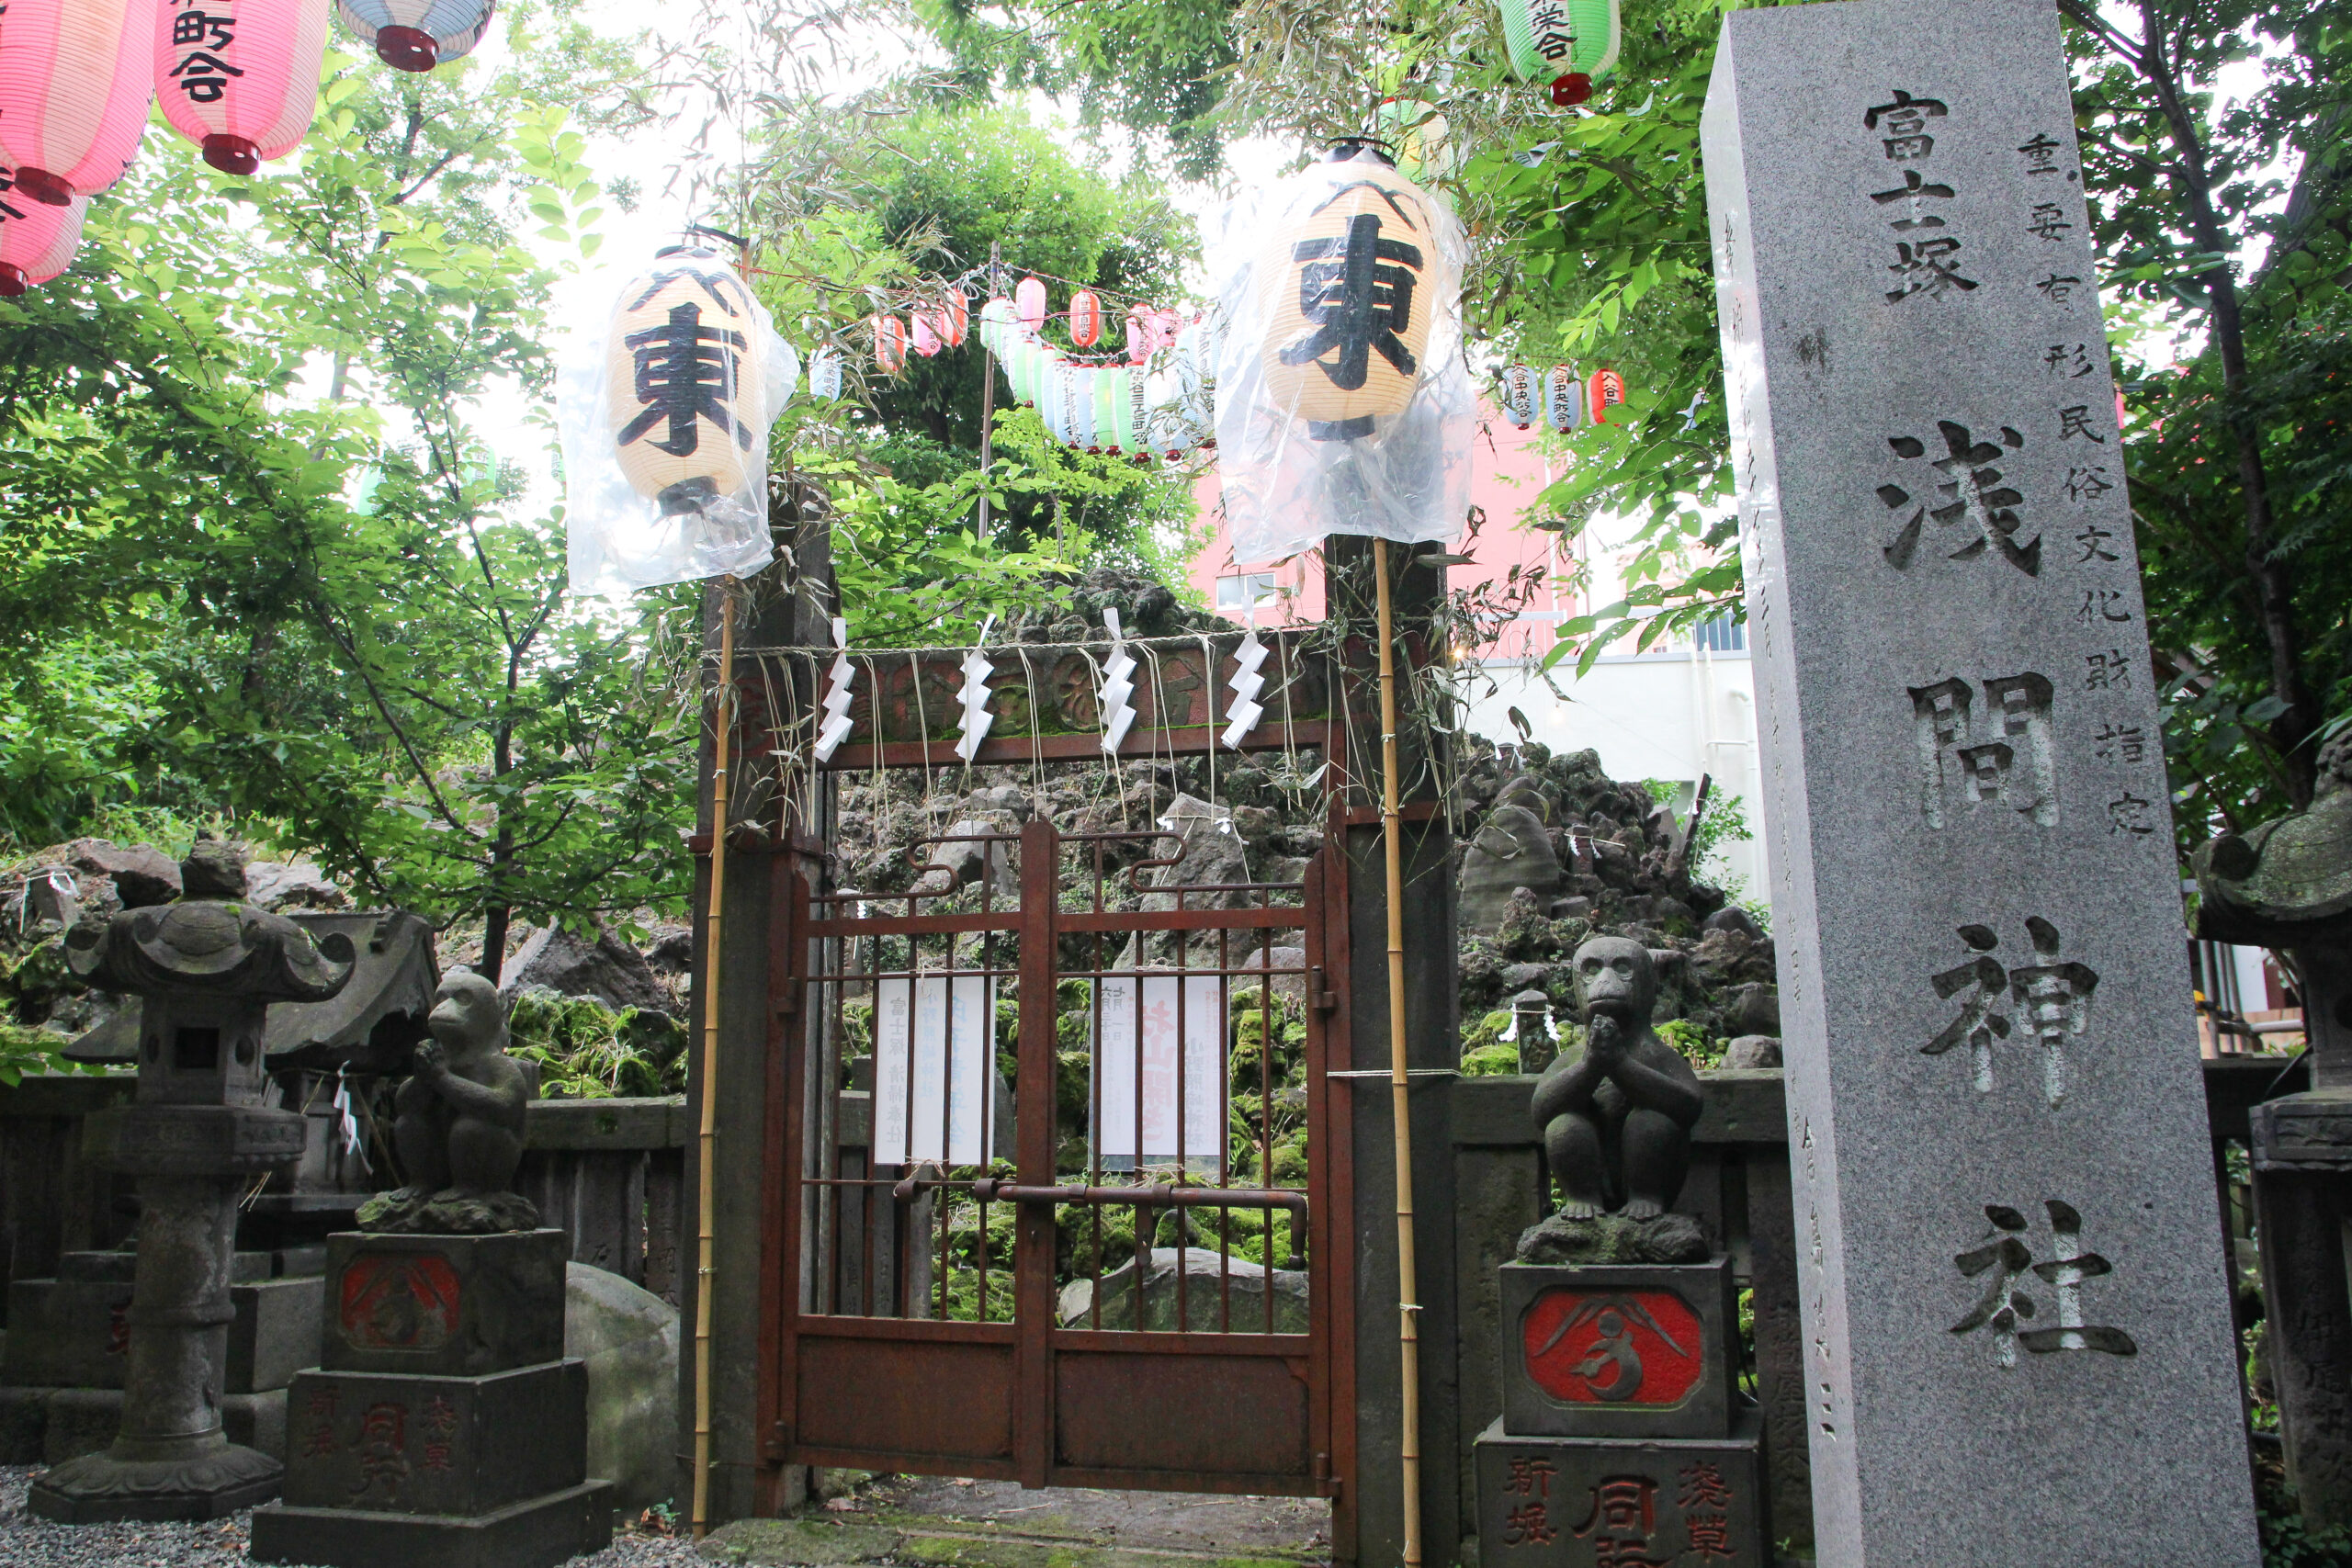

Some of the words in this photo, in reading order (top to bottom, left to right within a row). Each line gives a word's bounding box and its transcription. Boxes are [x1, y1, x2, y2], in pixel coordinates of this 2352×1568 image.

[169, 0, 243, 103] 町会
[1531, 0, 1578, 61] 栄会
[1862, 89, 1979, 306] 富士塚
[2018, 133, 2155, 840] 重要有形民俗文化財指定
[1876, 420, 2138, 1369] 浅間神社
